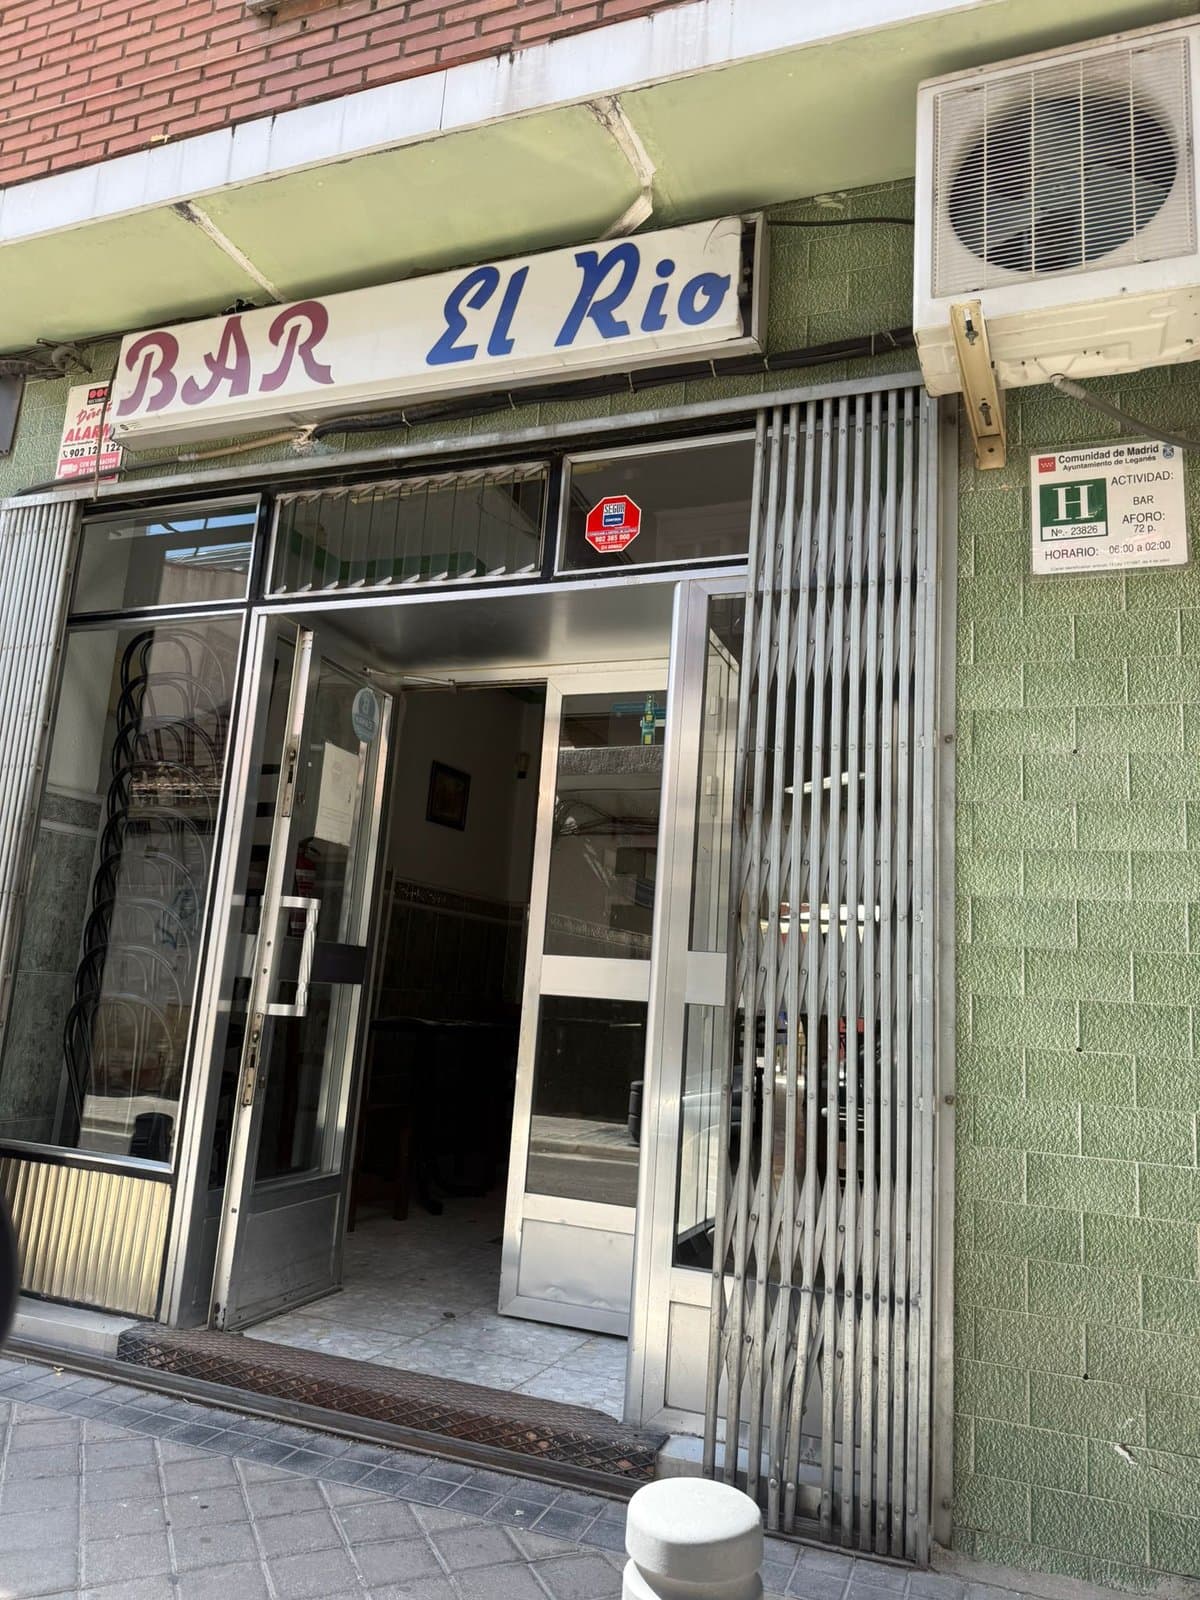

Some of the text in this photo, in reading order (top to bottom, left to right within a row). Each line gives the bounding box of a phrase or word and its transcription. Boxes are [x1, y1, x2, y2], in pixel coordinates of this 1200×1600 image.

[116, 242, 731, 416] BAR El Rio
[76, 401, 113, 426] Diret
[64, 423, 113, 443] ALARM
[69, 448, 85, 458] 902
[1058, 445, 1159, 464] Comunidad de Madrid
[1062, 454, 1157, 472] Ayuntamiento de Leganés
[1111, 470, 1174, 486] ACTIVIDAD:
[604, 503, 625, 514] SEGUR
[1052, 484, 1095, 522] H
[1133, 495, 1154, 505] BAR
[1122, 511, 1166, 525] AFORO:
[1070, 525, 1098, 536] 23826
[1133, 524, 1157, 534] 72 p.
[1044, 546, 1099, 561] HORARIO:
[1145, 540, 1171, 551] 02:00
